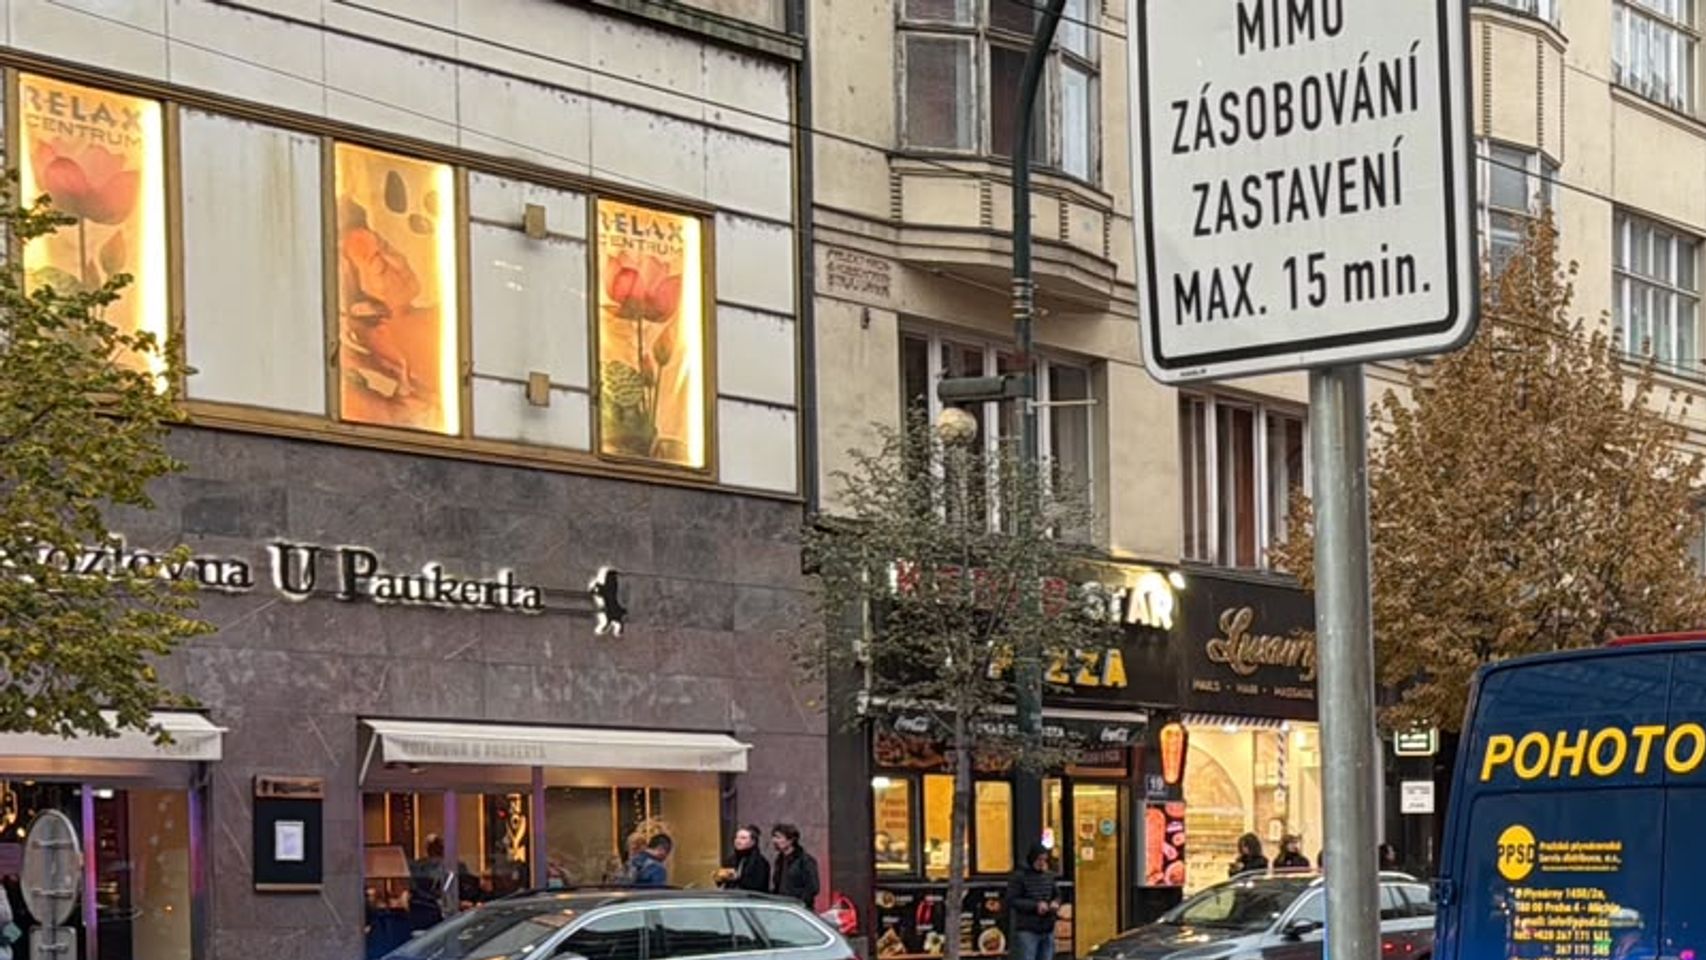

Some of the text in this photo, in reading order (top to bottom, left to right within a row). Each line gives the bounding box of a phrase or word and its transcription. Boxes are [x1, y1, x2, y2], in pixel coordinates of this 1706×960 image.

[1236, 0, 1343, 55] MIMO
[25, 85, 142, 132] RELAX
[1171, 40, 1420, 154] ZÁSOBOVÁNÍ
[25, 113, 142, 147] CENTRUM
[1192, 135, 1403, 237] ZASTAVENÍ
[1174, 243, 1430, 325] MAX. 15 min.
[8, 533, 545, 612] ozlovna U Paukerta
[985, 644, 1127, 687] PZZA
[1497, 843, 1536, 865] PPSD
